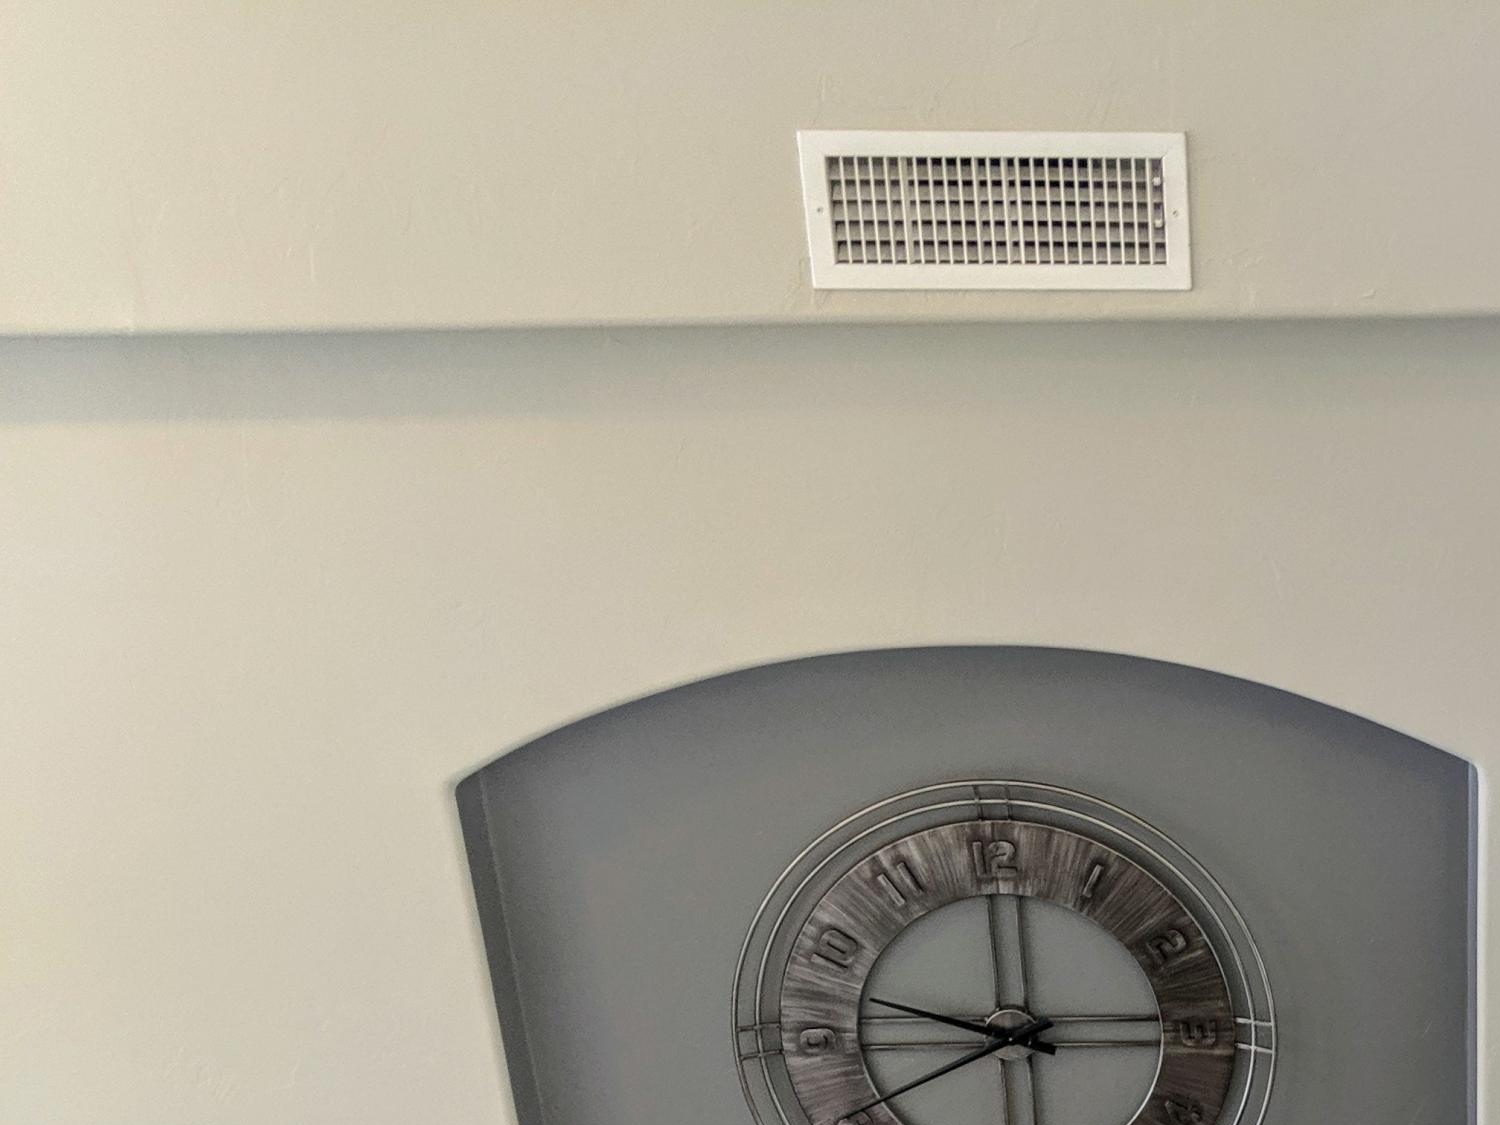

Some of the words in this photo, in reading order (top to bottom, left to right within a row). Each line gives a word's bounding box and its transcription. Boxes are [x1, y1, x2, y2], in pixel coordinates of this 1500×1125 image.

[971, 840, 1019, 880] 12
[877, 861, 925, 906] 11
[1083, 864, 1104, 898] 1
[811, 928, 859, 970] 10
[1148, 928, 1187, 965] 2
[800, 1027, 836, 1054] 9
[1179, 1020, 1218, 1047] 3
